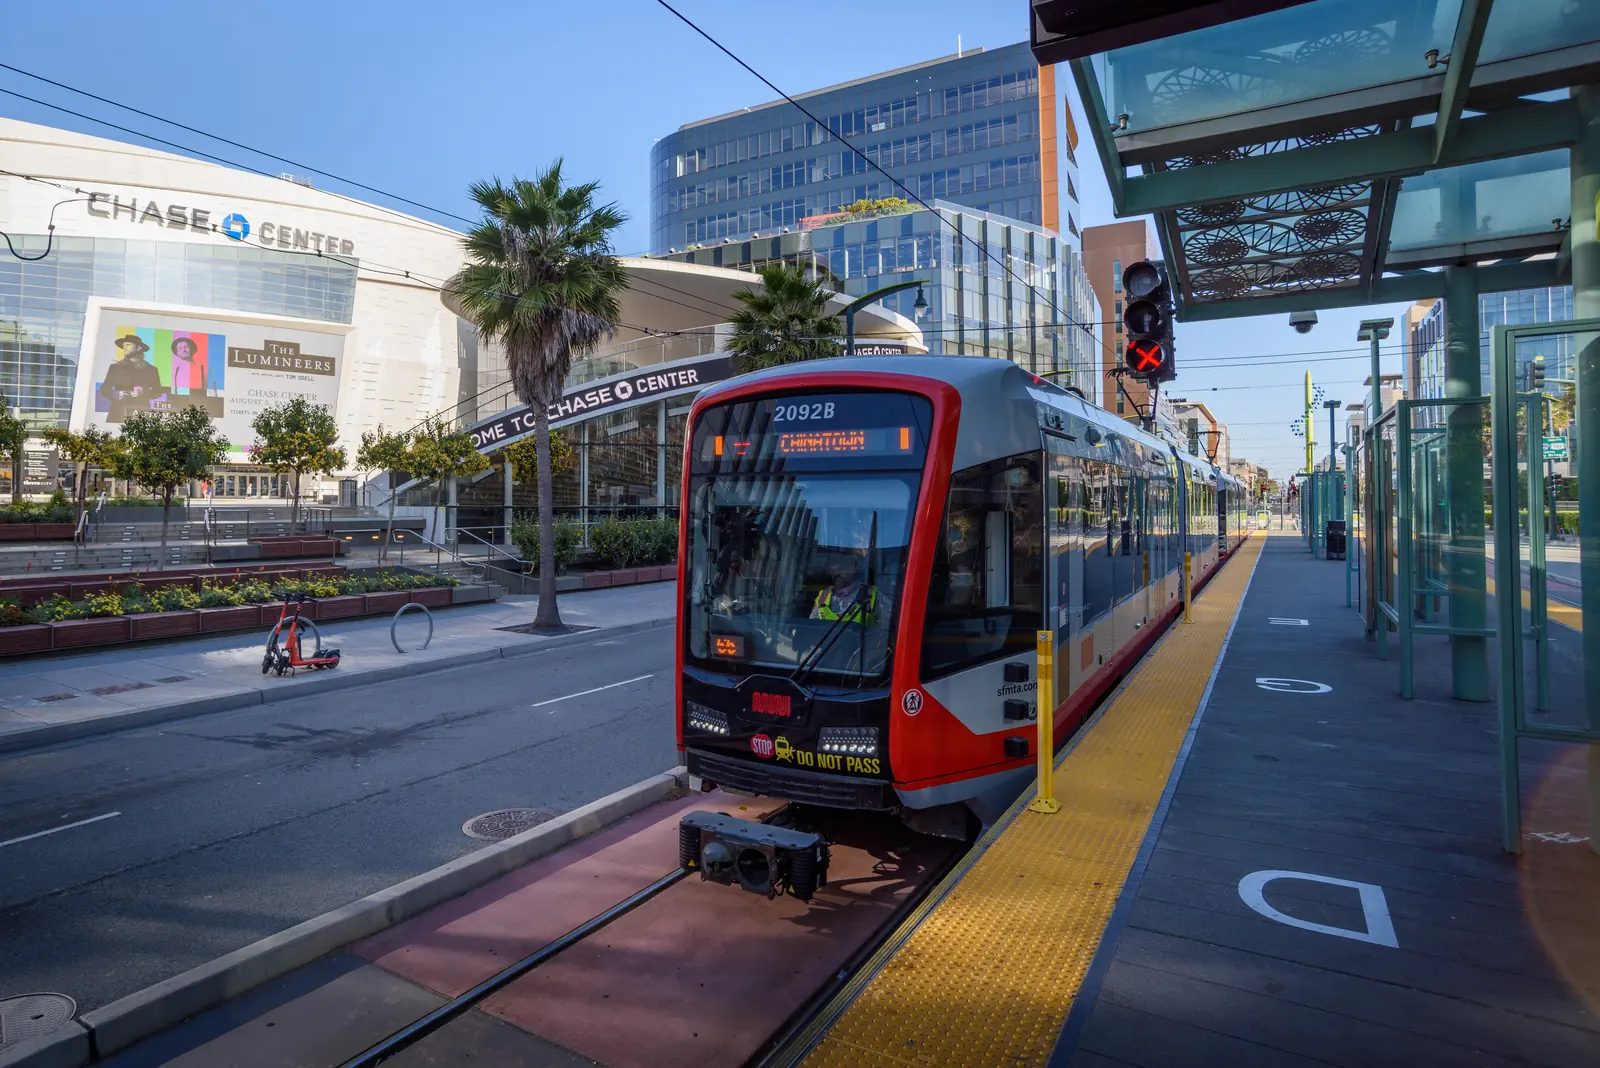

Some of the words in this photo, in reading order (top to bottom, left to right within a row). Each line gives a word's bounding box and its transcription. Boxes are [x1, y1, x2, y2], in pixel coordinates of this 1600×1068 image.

[87, 191, 212, 234] CHASE
[259, 221, 355, 255] CENTER
[269, 343, 295, 355] THE
[233, 349, 331, 371] LUMINEERS
[230, 397, 263, 405] AUGUST
[248, 388, 279, 399] CHASE
[281, 391, 317, 401] CENTER
[510, 412, 536, 432] TO
[547, 386, 613, 420] CHASE
[636, 369, 699, 394] CENTER
[773, 402, 836, 422] 2092B
[780, 430, 865, 452] CHINATOWN
[752, 737, 773, 755] STOP
[796, 750, 814, 767] DO
[817, 753, 843, 771] NOT
[847, 757, 881, 774] PASS
